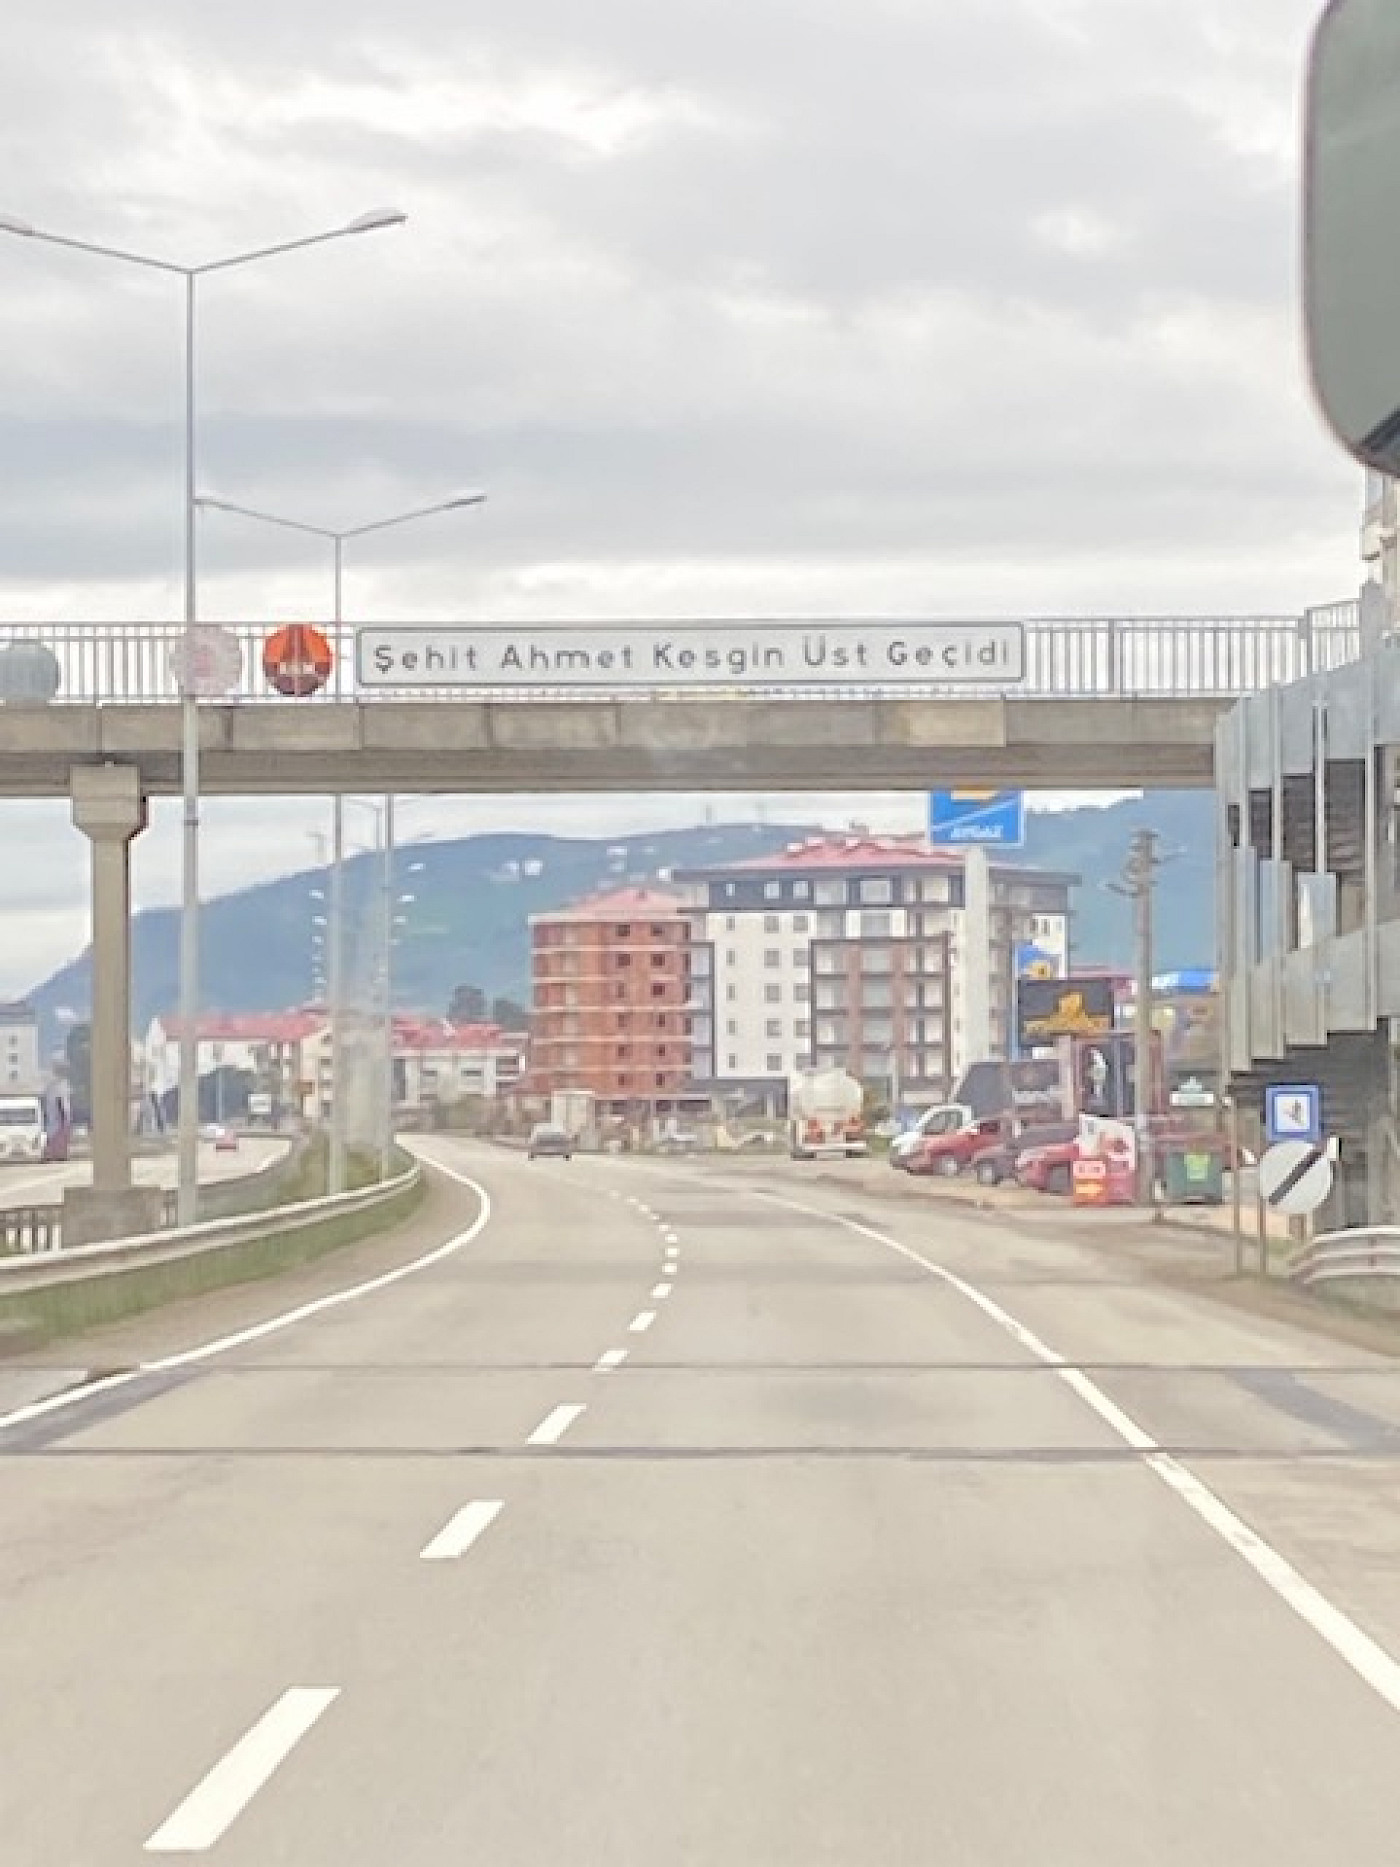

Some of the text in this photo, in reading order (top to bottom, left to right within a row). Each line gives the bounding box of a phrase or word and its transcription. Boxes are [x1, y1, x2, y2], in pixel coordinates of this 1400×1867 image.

[373, 635, 1010, 674] Şehit Ahmet Kesgin Üst Geçidi
